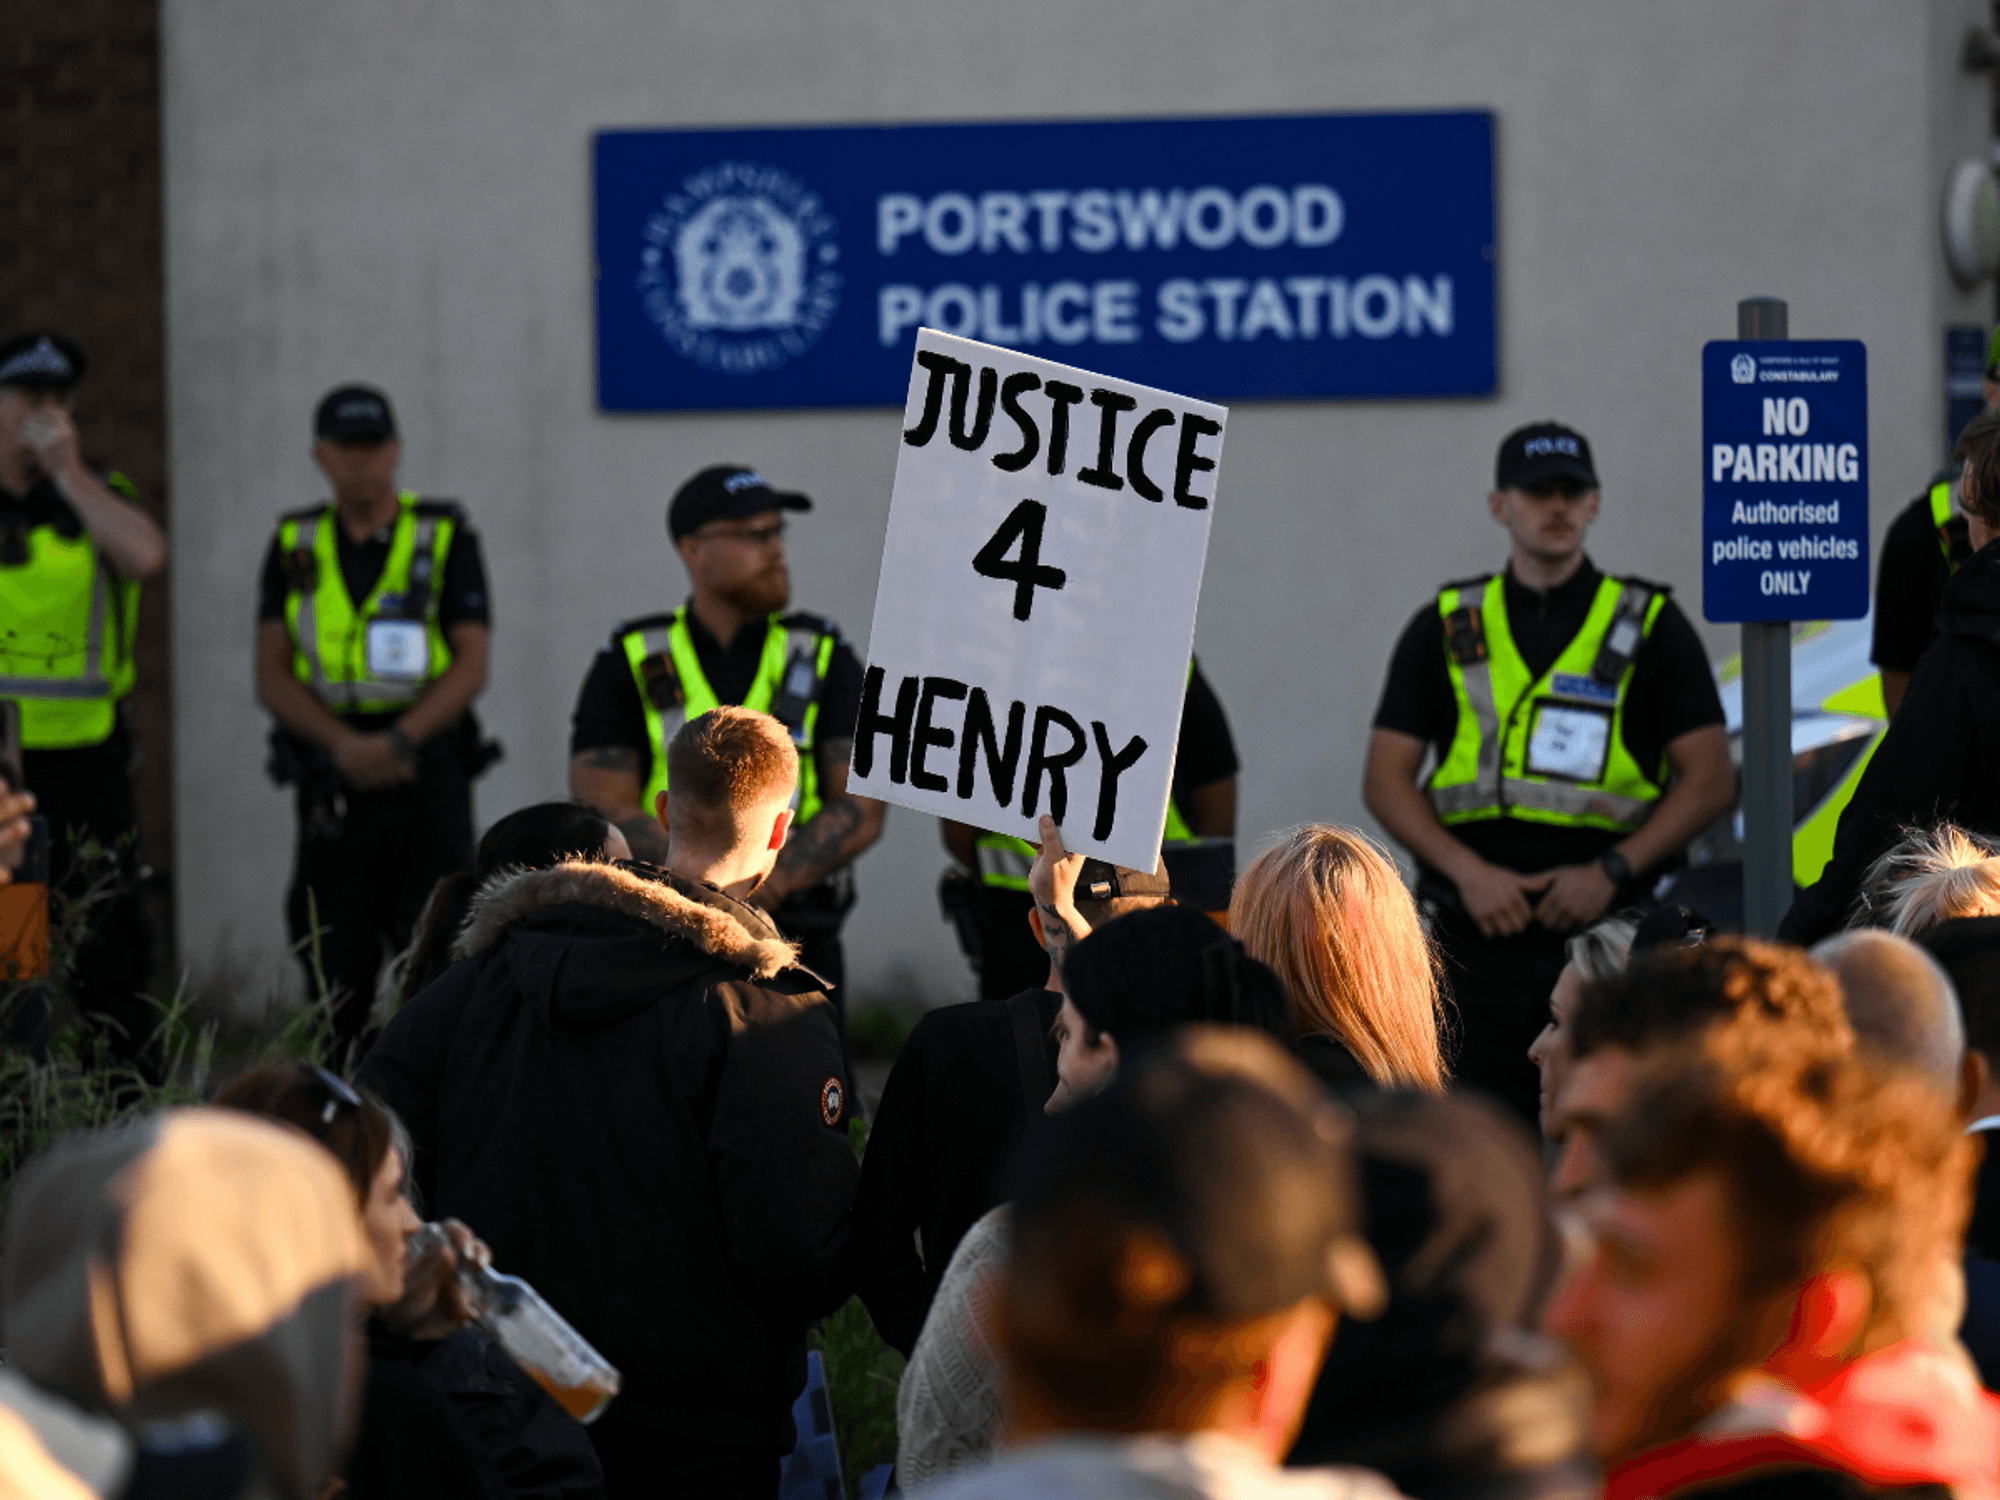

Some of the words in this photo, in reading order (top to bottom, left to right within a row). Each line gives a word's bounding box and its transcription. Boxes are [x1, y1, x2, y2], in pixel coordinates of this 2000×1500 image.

[878, 185, 1343, 254] PORTSWOOD
[879, 279, 1140, 347] POLICE
[1159, 275, 1452, 340] STATION
[903, 350, 1222, 509] JUSTICE
[1763, 397, 1810, 436] NO
[1713, 444, 1859, 482] PARKING
[1731, 500, 1840, 525] Authorised
[972, 499, 1067, 622] 4
[1712, 535, 1773, 565] police
[1778, 535, 1859, 560] vehicles
[1760, 571, 1811, 596] ONLY
[853, 663, 1148, 841] HENRY
